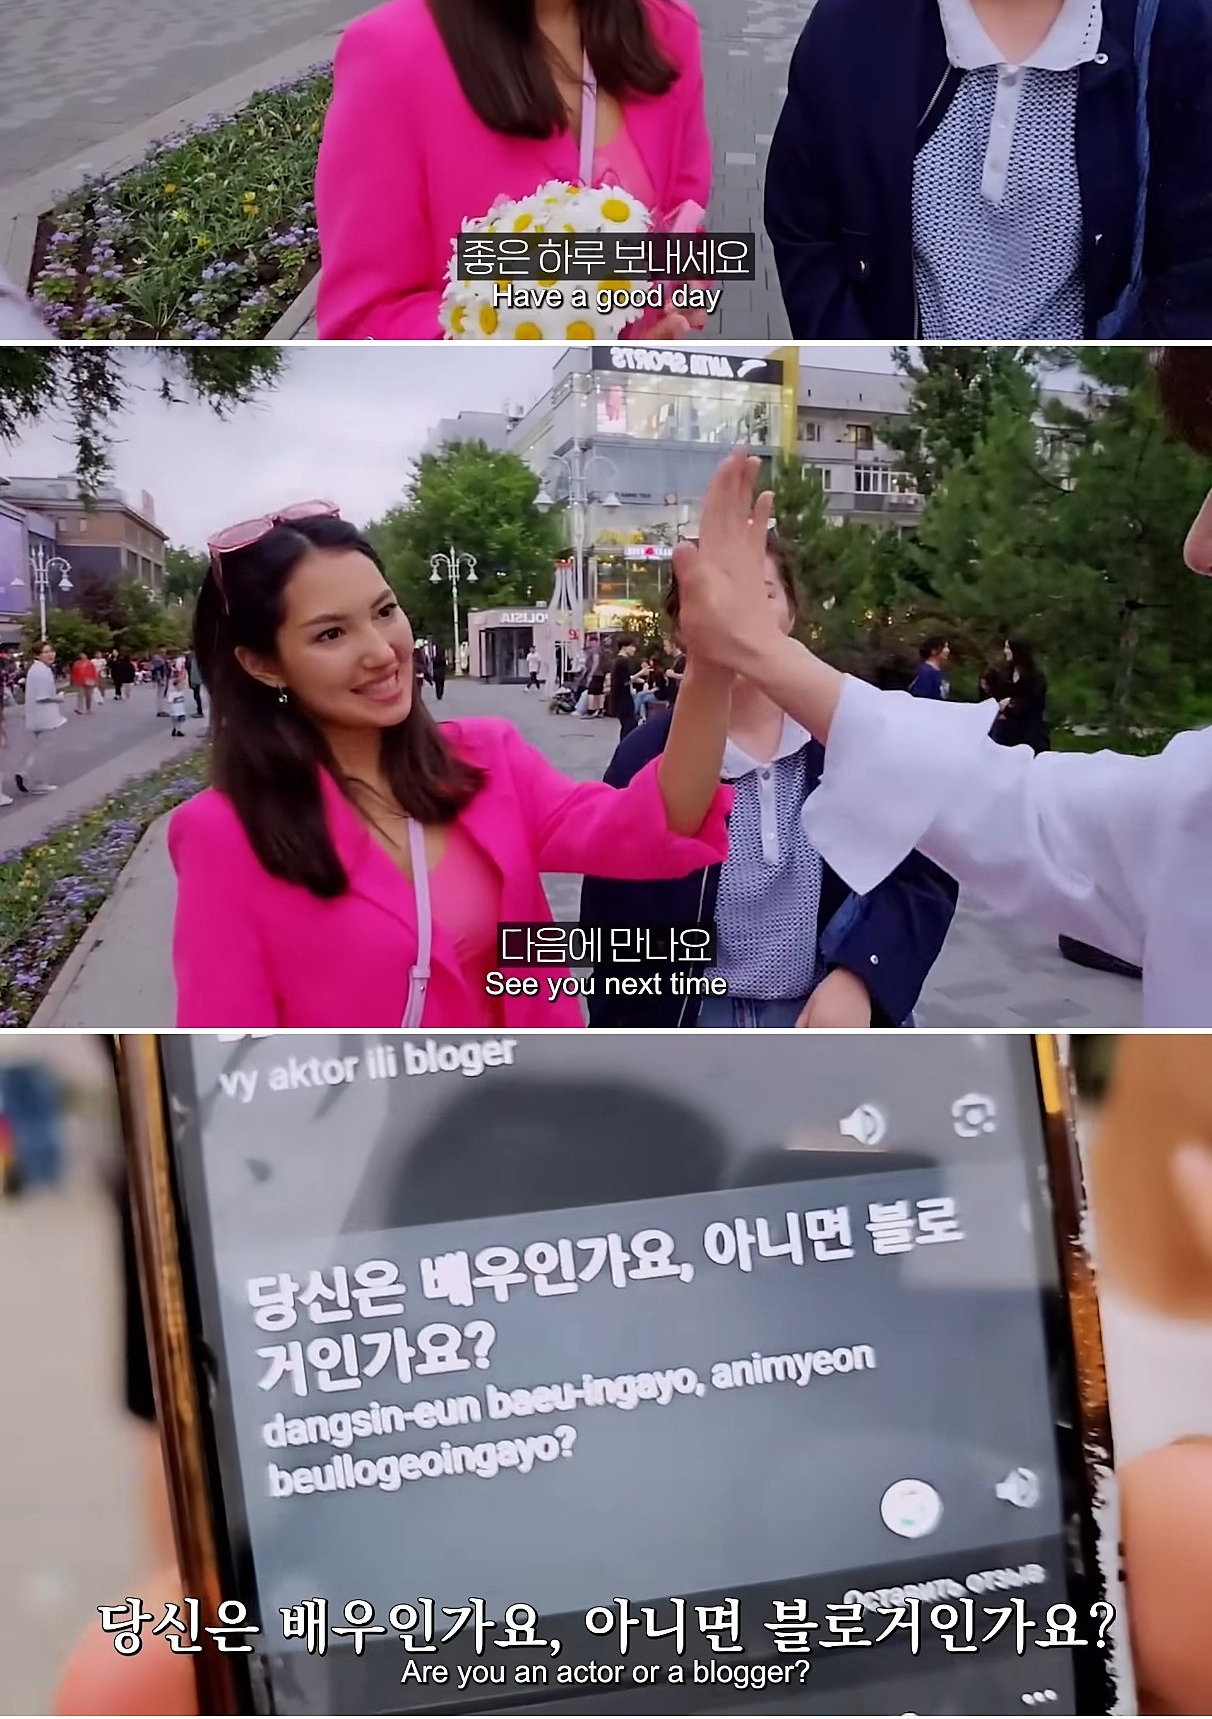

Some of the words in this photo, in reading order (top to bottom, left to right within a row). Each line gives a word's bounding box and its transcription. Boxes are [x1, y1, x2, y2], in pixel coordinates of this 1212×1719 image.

[219, 1068, 258, 1103] vy
[268, 1055, 360, 1091] aktor
[365, 1046, 398, 1080] ili
[403, 1038, 517, 1078] bloger
[248, 1259, 406, 1331] 당신은
[420, 1229, 695, 1307] 배우인가요,
[703, 1205, 855, 1273] 아니면
[865, 1197, 965, 1256] 블로
[256, 1320, 497, 1397] 거인가요?
[262, 1394, 482, 1449] dangsin-eun
[486, 1366, 706, 1420] baeu-ingayo,
[711, 1344, 876, 1389] animyeon
[269, 1425, 577, 1498] beullogeoingayo?
